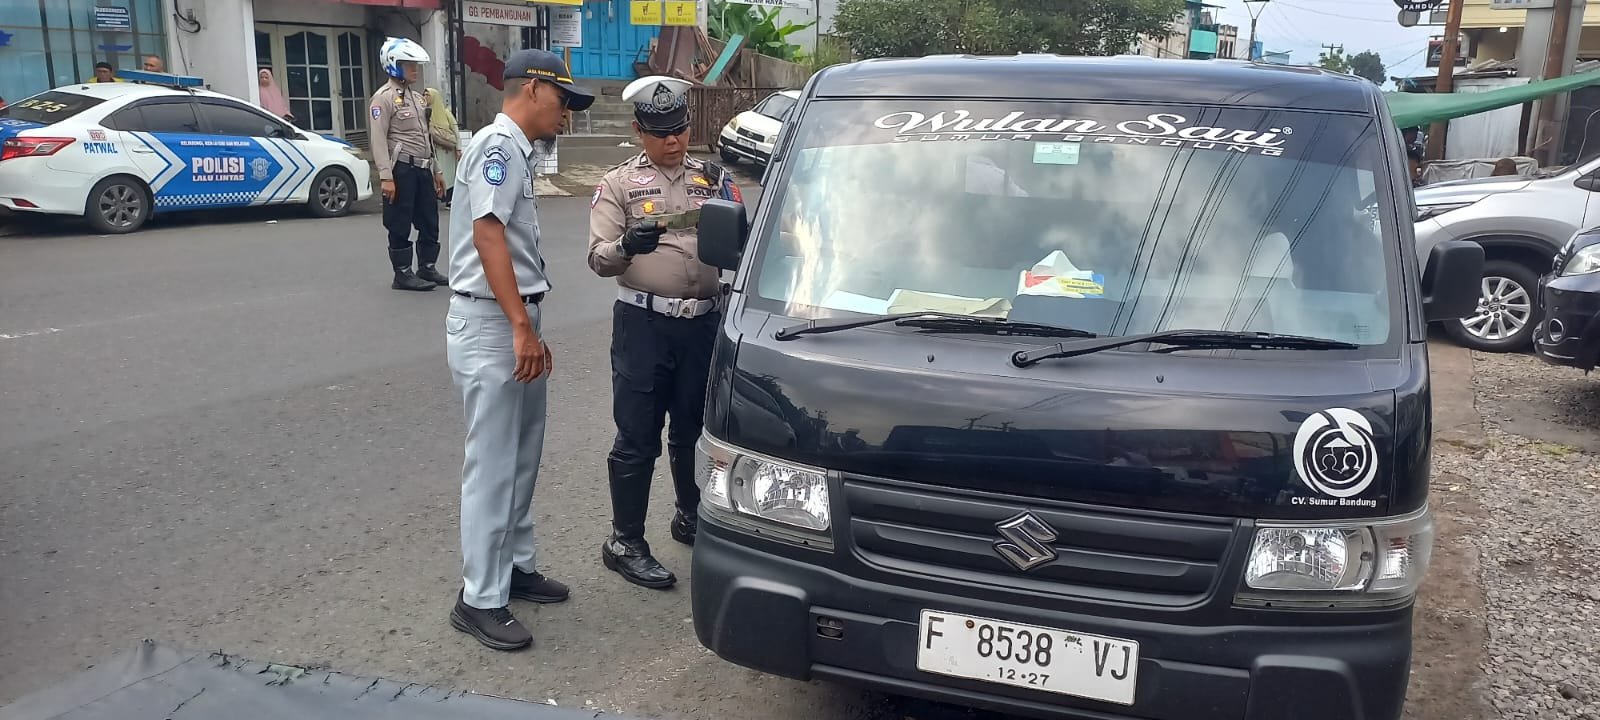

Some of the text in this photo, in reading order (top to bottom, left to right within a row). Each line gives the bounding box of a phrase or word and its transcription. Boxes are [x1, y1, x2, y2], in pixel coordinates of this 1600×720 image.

[481, 7, 531, 21] PEMBANGUNAN
[874, 110, 1105, 134] Wulan
[83, 142, 118, 154] PATWAL
[1063, 134, 1284, 156] BANDUNG
[192, 157, 245, 173] POLISI
[192, 174, 214, 182] LALU
[1291, 496, 1377, 508] CV. Sumur Bandung
[926, 616, 1131, 681] F 8538 VJ
